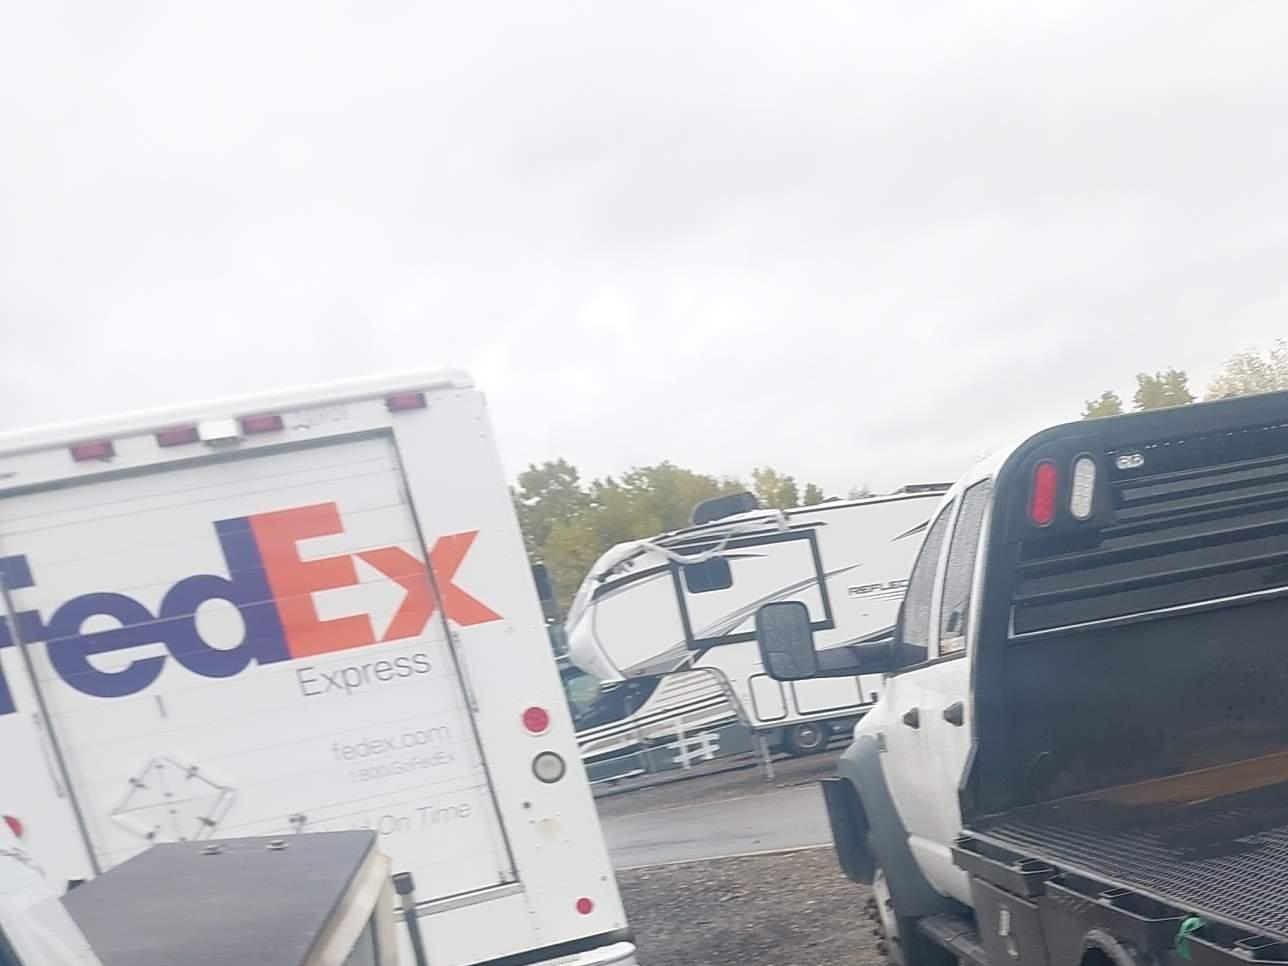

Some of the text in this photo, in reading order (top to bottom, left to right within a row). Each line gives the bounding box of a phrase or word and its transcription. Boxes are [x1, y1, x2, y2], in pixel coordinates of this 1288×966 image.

[296, 653, 432, 697] Express
[331, 726, 452, 762] fedex.com
[378, 814, 412, 836] On
[415, 803, 473, 828] Time
